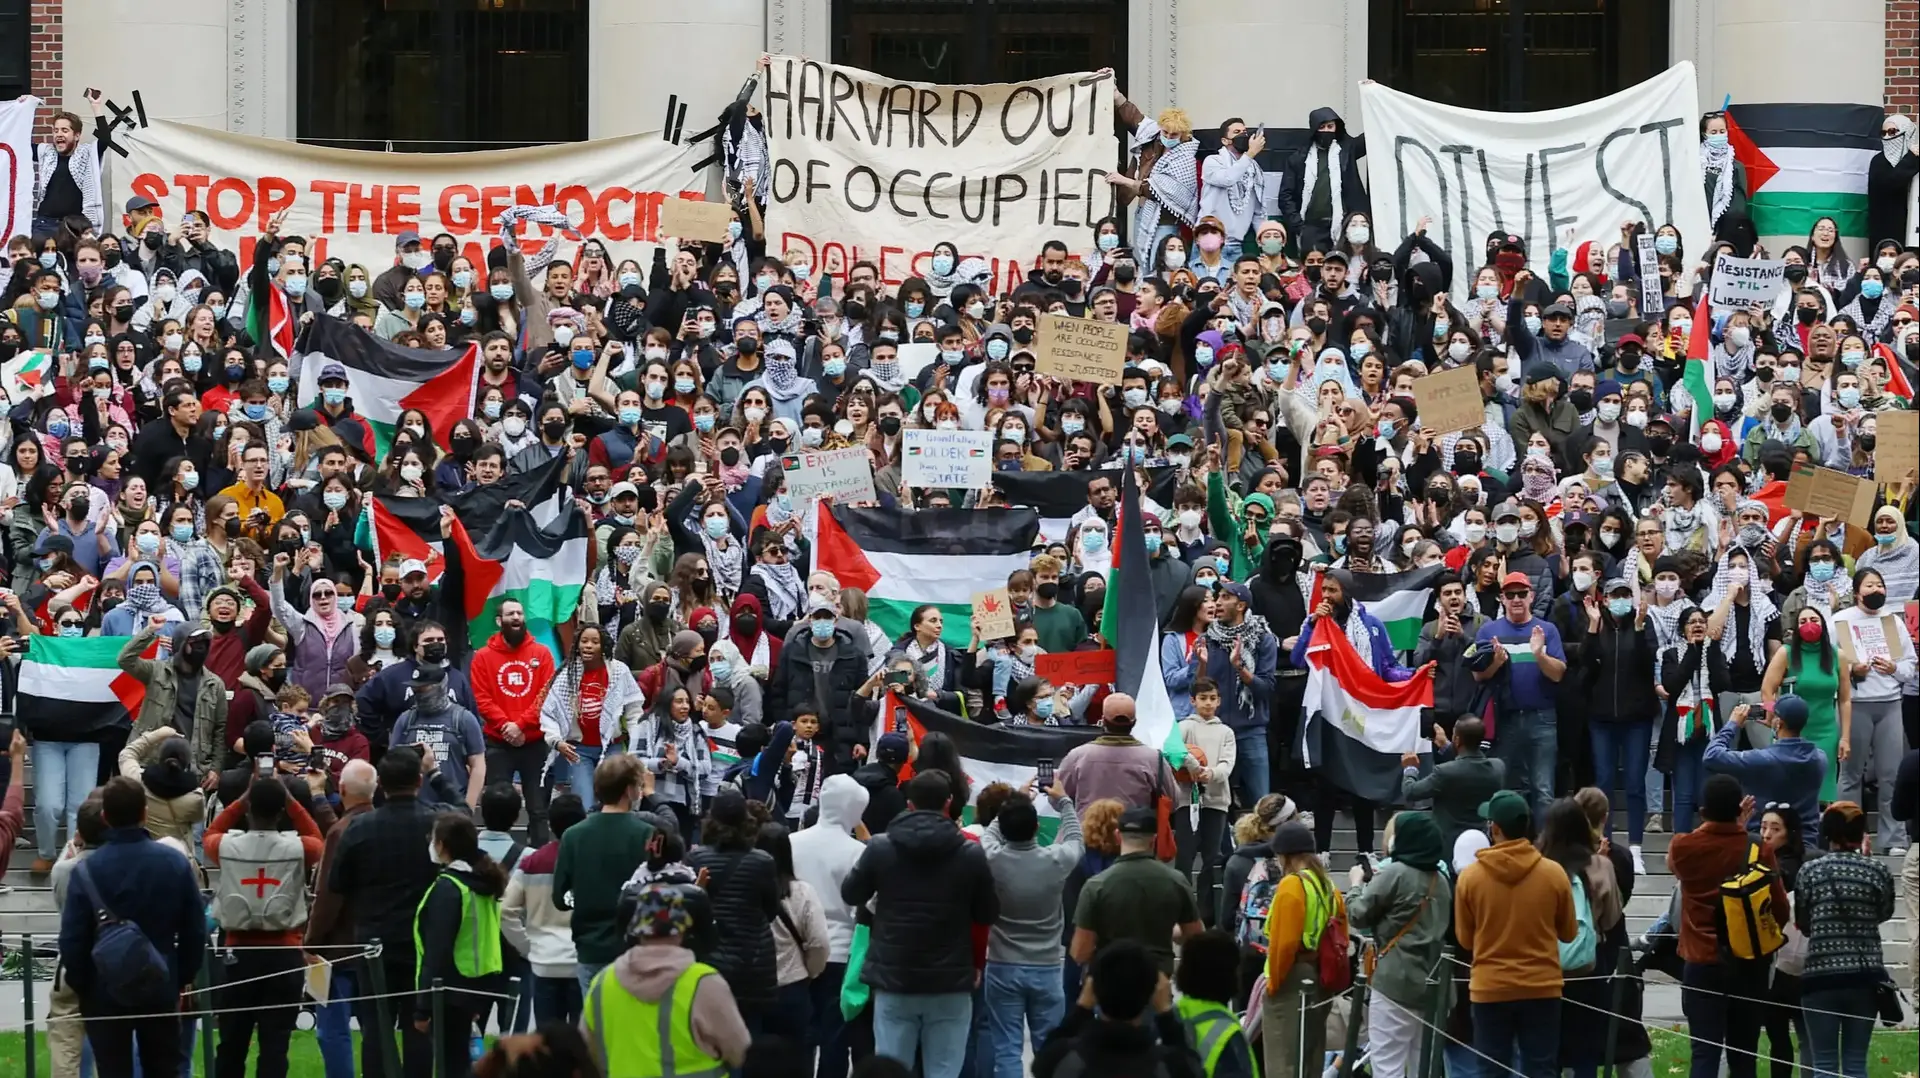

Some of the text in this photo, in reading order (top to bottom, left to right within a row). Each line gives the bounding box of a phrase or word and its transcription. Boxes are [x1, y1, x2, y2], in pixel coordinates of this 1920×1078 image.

[765, 59, 1112, 148] HARVARD OUT
[772, 158, 1116, 229] OF OCCUPIED
[1395, 117, 1684, 288] DIVEST
[123, 173, 296, 234] STOP
[310, 180, 421, 235] THE
[1053, 321, 1116, 339] WHEN PEOPLE
[1054, 333, 1118, 351] ARE OCCUPIED
[1051, 347, 1103, 363] RESISTANCE
[1053, 362, 1118, 378] IS JUSTIFIED
[924, 446, 967, 459] OLDER
[821, 465, 836, 477] IS
